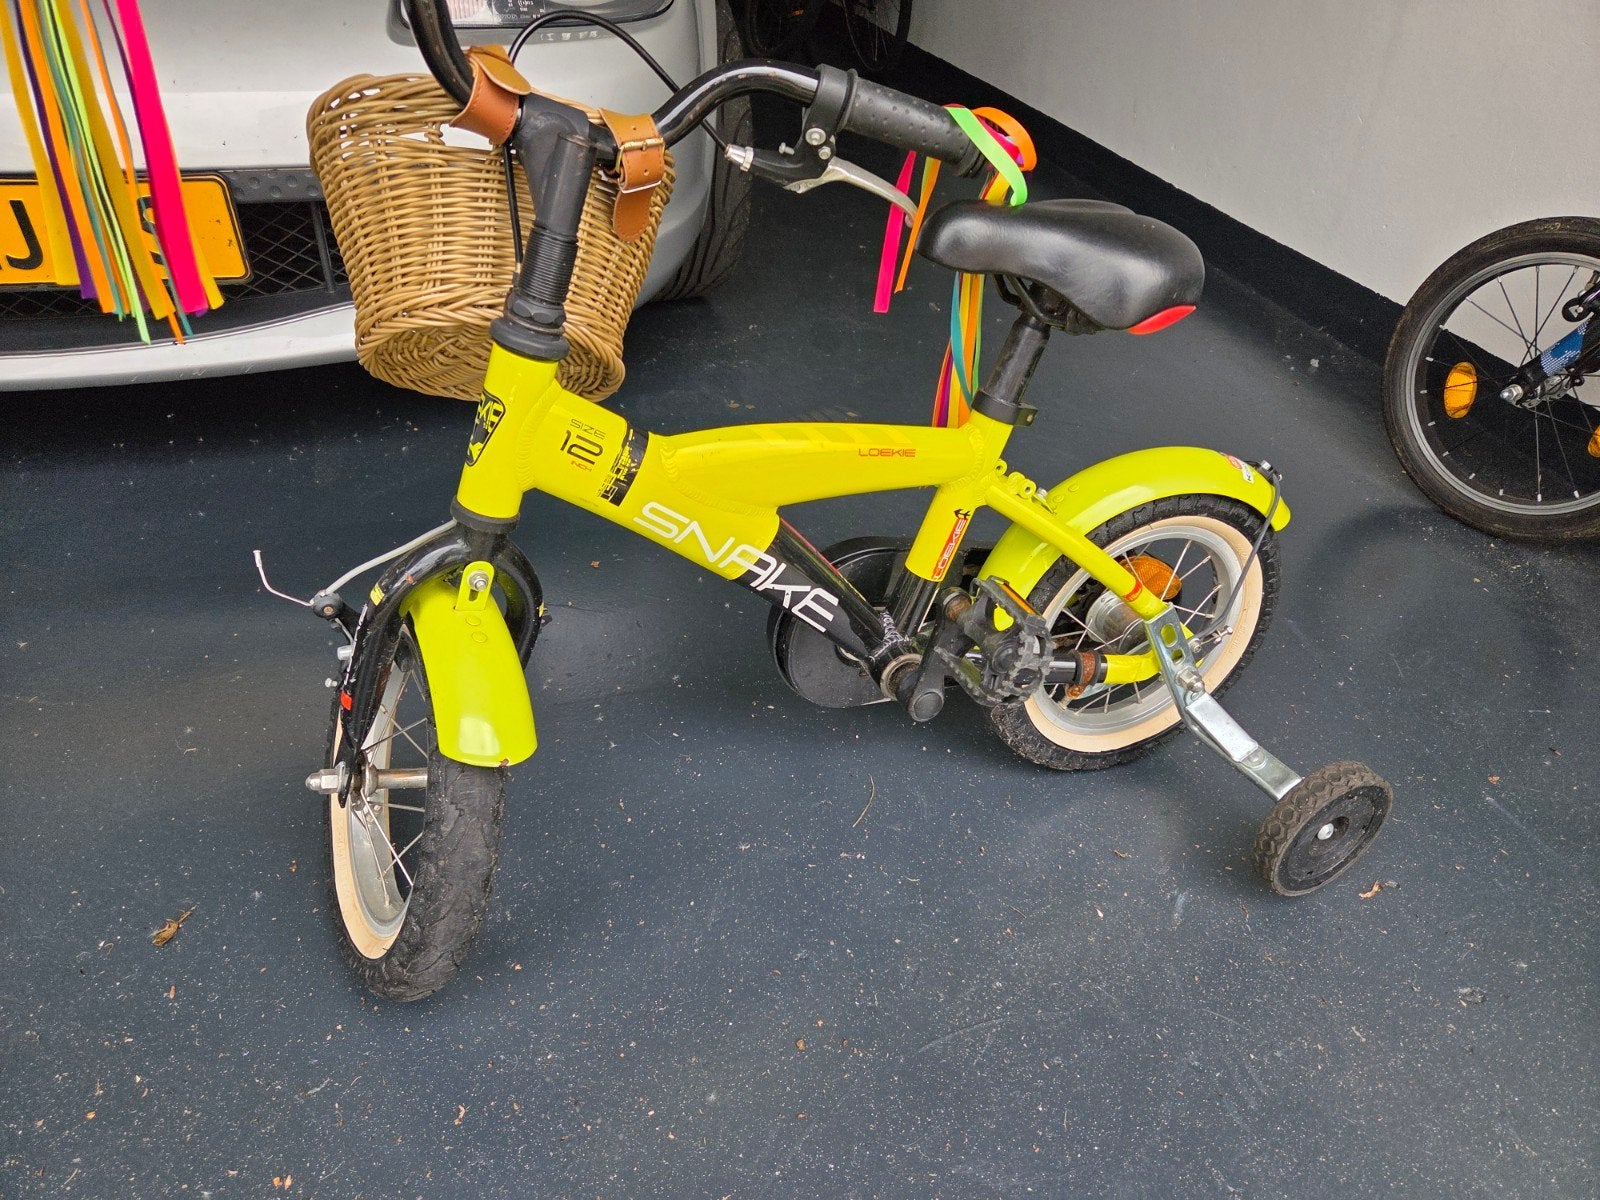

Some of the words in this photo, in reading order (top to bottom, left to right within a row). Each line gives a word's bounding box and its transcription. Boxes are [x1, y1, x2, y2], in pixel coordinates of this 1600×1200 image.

[0, 199, 43, 270] J
[560, 430, 604, 466] 12
[571, 418, 606, 440] SIZE
[858, 448, 916, 457] LOEKIE
[633, 502, 839, 632] SNAKE
[934, 519, 967, 579] LOEKIE
